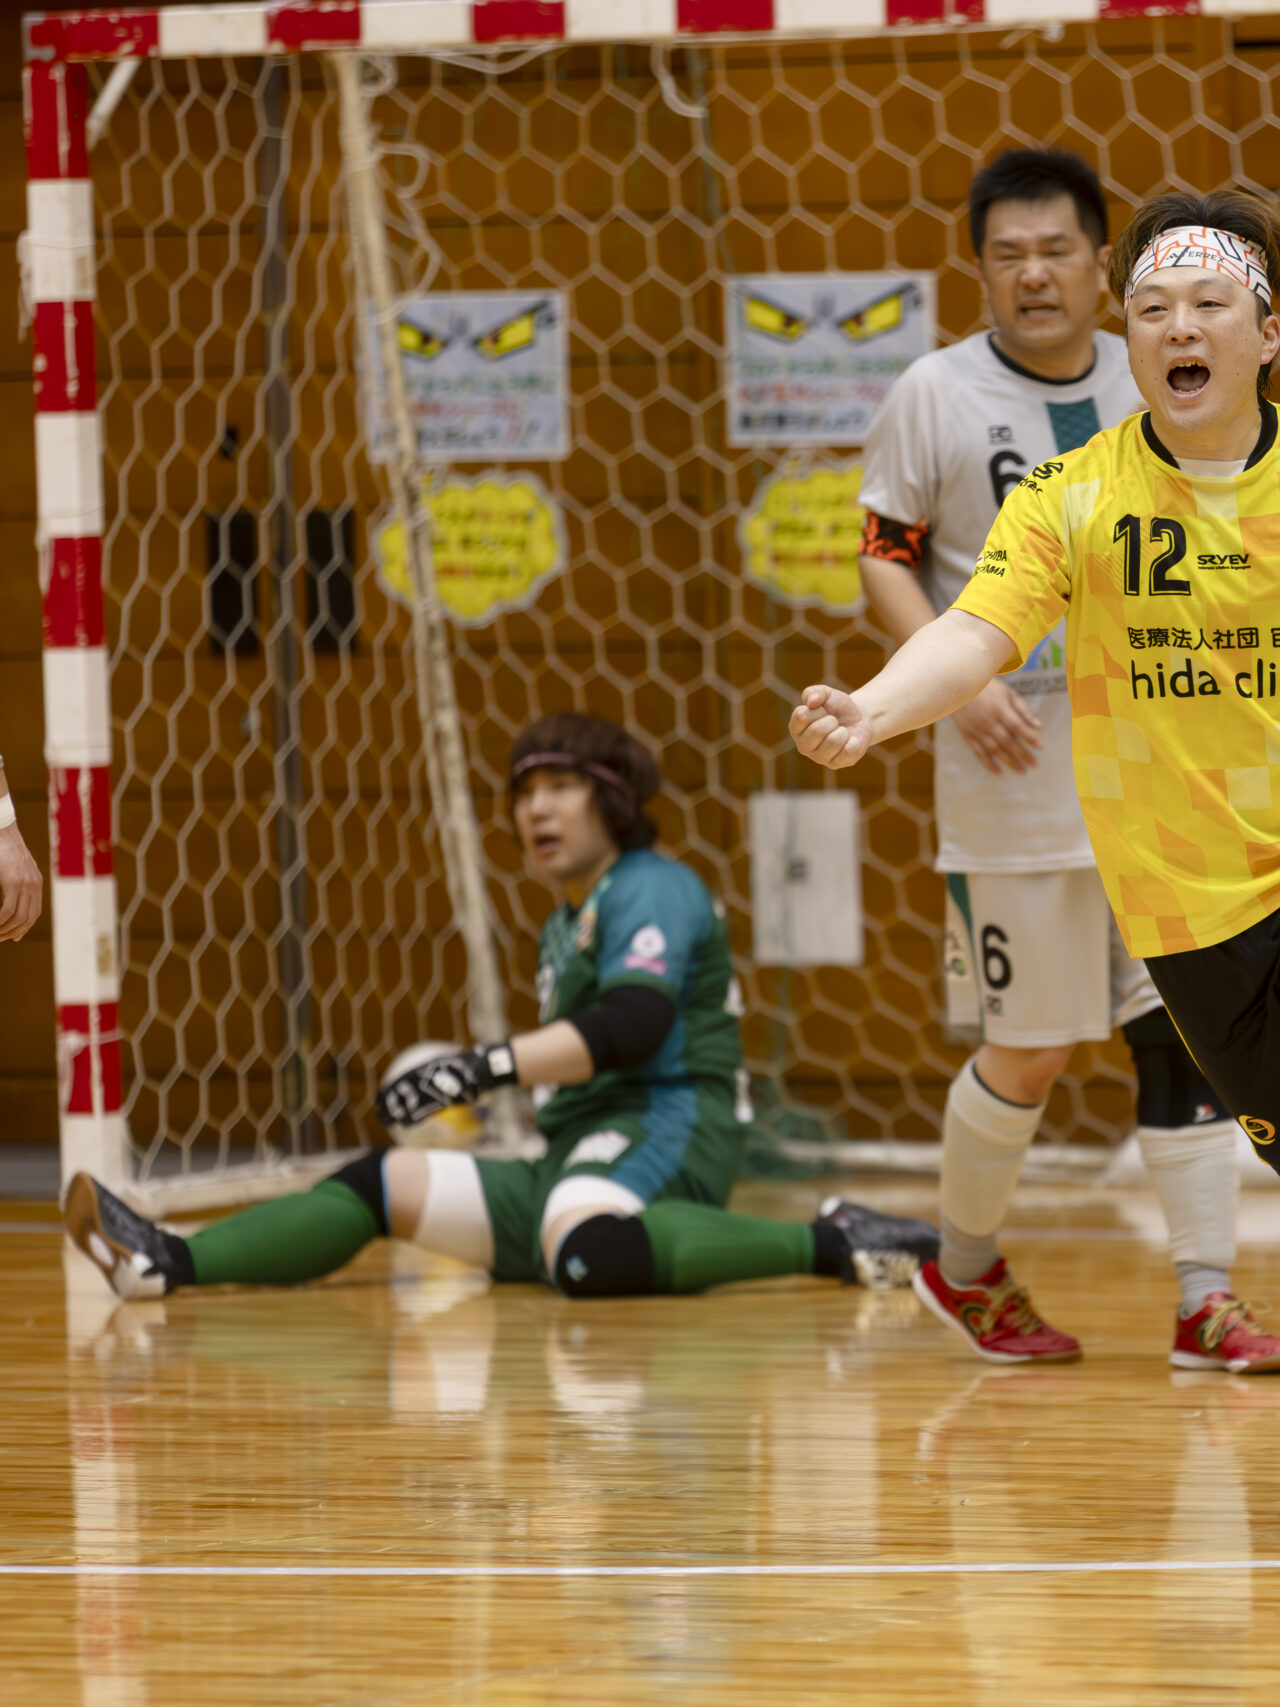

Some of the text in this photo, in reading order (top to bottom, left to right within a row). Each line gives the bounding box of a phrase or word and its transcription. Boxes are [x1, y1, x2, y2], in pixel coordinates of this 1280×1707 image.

[1182, 250, 1225, 265] TERREX
[1113, 513, 1192, 597] 12
[1127, 626, 1260, 651] 医療法人社団
[1130, 658, 1221, 700] hida
[981, 924, 1012, 992] 6
